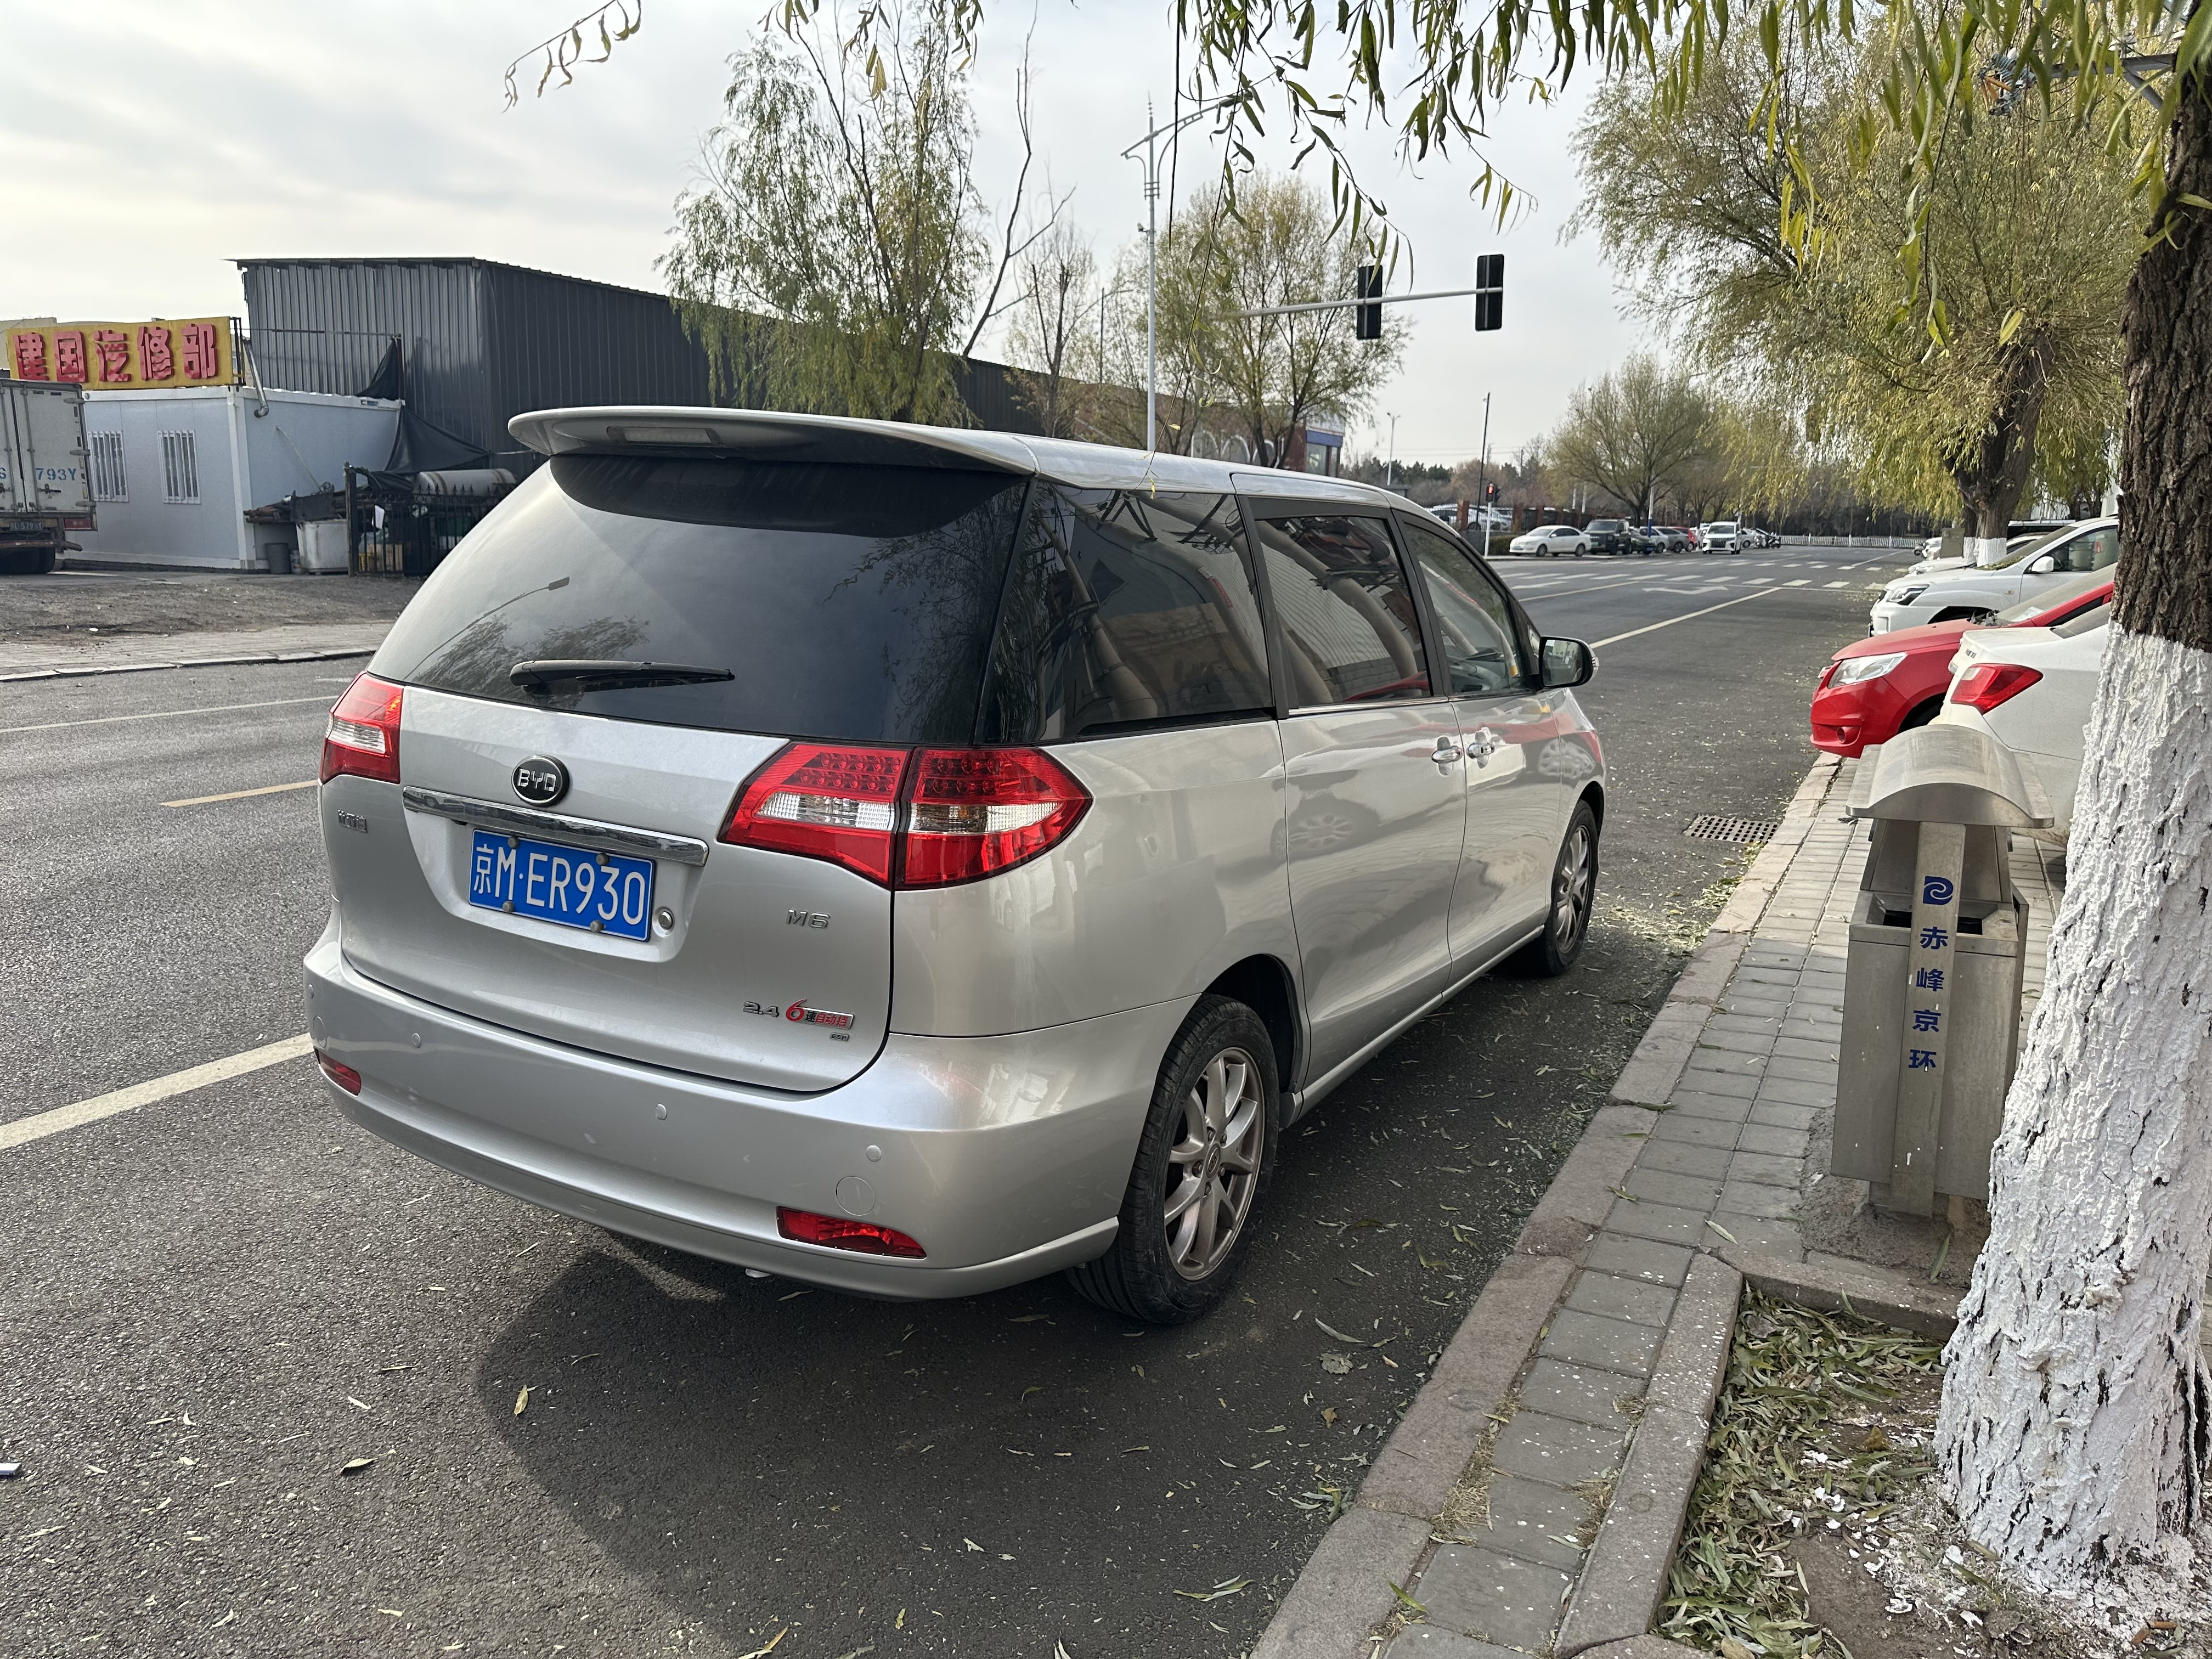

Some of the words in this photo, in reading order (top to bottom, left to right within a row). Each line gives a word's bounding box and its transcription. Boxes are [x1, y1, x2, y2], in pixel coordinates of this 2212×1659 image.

[13, 324, 218, 382] 建国汽修部
[35, 467, 76, 481] 793Y
[517, 769, 556, 792] BYD
[786, 909, 830, 929] M6
[743, 1001, 779, 1017] 2.4
